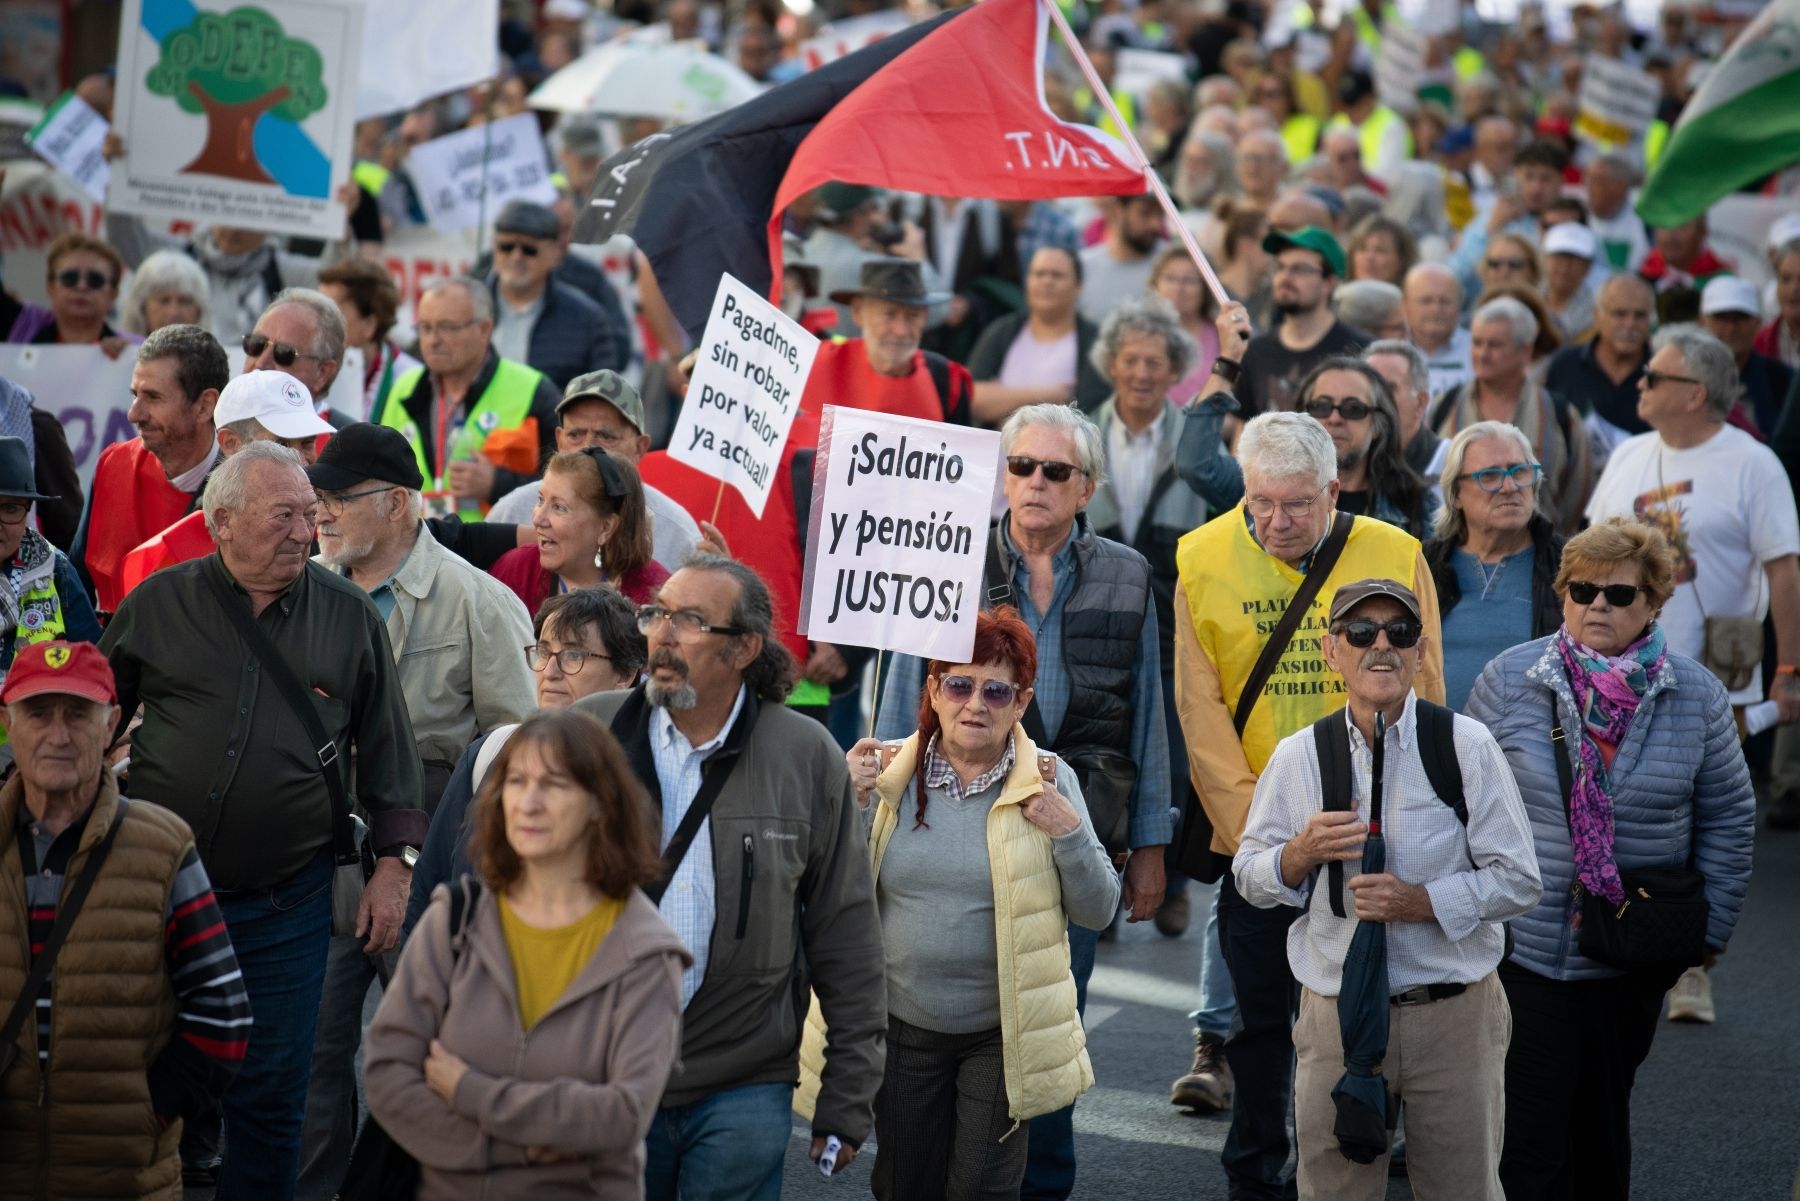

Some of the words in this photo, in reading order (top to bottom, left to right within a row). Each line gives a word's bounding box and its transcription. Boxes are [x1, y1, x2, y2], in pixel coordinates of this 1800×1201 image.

[157, 19, 316, 108] MODEPEN
[721, 293, 799, 373] Pagadme,
[711, 340, 739, 372] sin
[744, 360, 790, 414] robar,
[699, 384, 737, 414] por
[743, 404, 778, 448] valor
[689, 424, 714, 450] ya
[719, 439, 769, 490] actual!
[847, 432, 964, 486] ¡Salario
[829, 512, 848, 554] y
[856, 510, 972, 556] pensión
[828, 568, 963, 623] JUSTOS!
